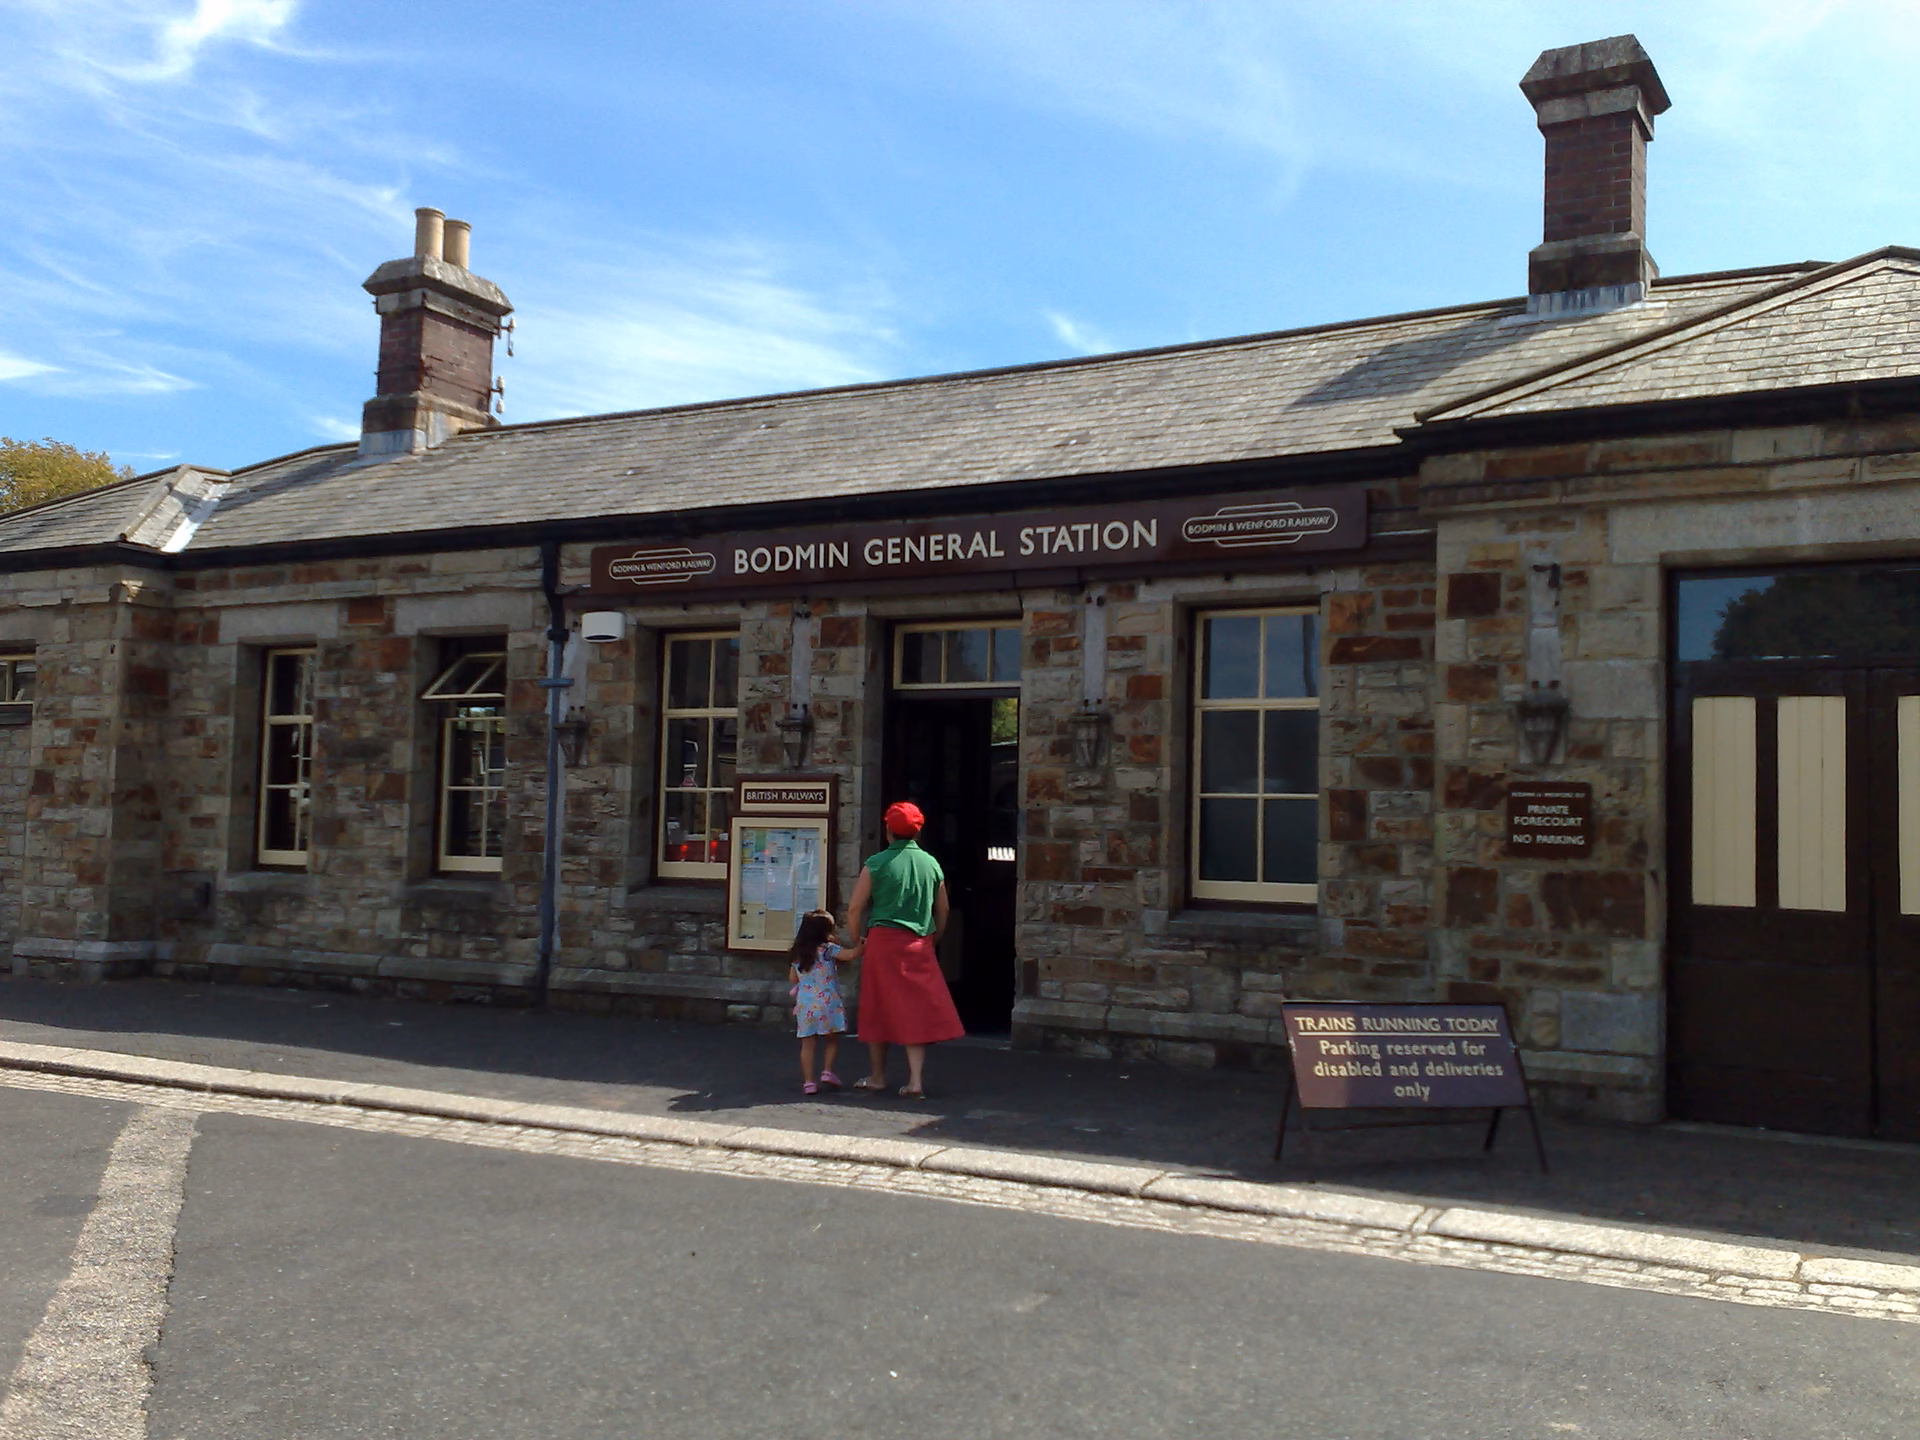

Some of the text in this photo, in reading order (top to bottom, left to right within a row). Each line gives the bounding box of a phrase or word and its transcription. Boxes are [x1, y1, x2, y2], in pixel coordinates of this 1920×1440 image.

[1187, 515, 1331, 534] BODMIN & WENFORD RAILWAY
[733, 517, 1158, 574] BODMIN GENERAL STATION
[612, 563, 640, 573] BODMIN
[682, 559, 711, 569] RAILWAY
[746, 791, 824, 801] BRITISH RAILWAYS
[1527, 804, 1570, 815] PRIVATE
[1513, 816, 1583, 827] FORECOURT
[1512, 833, 1585, 846] NO PARKING
[1294, 1016, 1498, 1032] TRAINS RUNNING TODAY
[1319, 1040, 1487, 1059] Parking reserved for
[1313, 1061, 1504, 1077] disabled and deliveries
[1393, 1082, 1431, 1102] only
